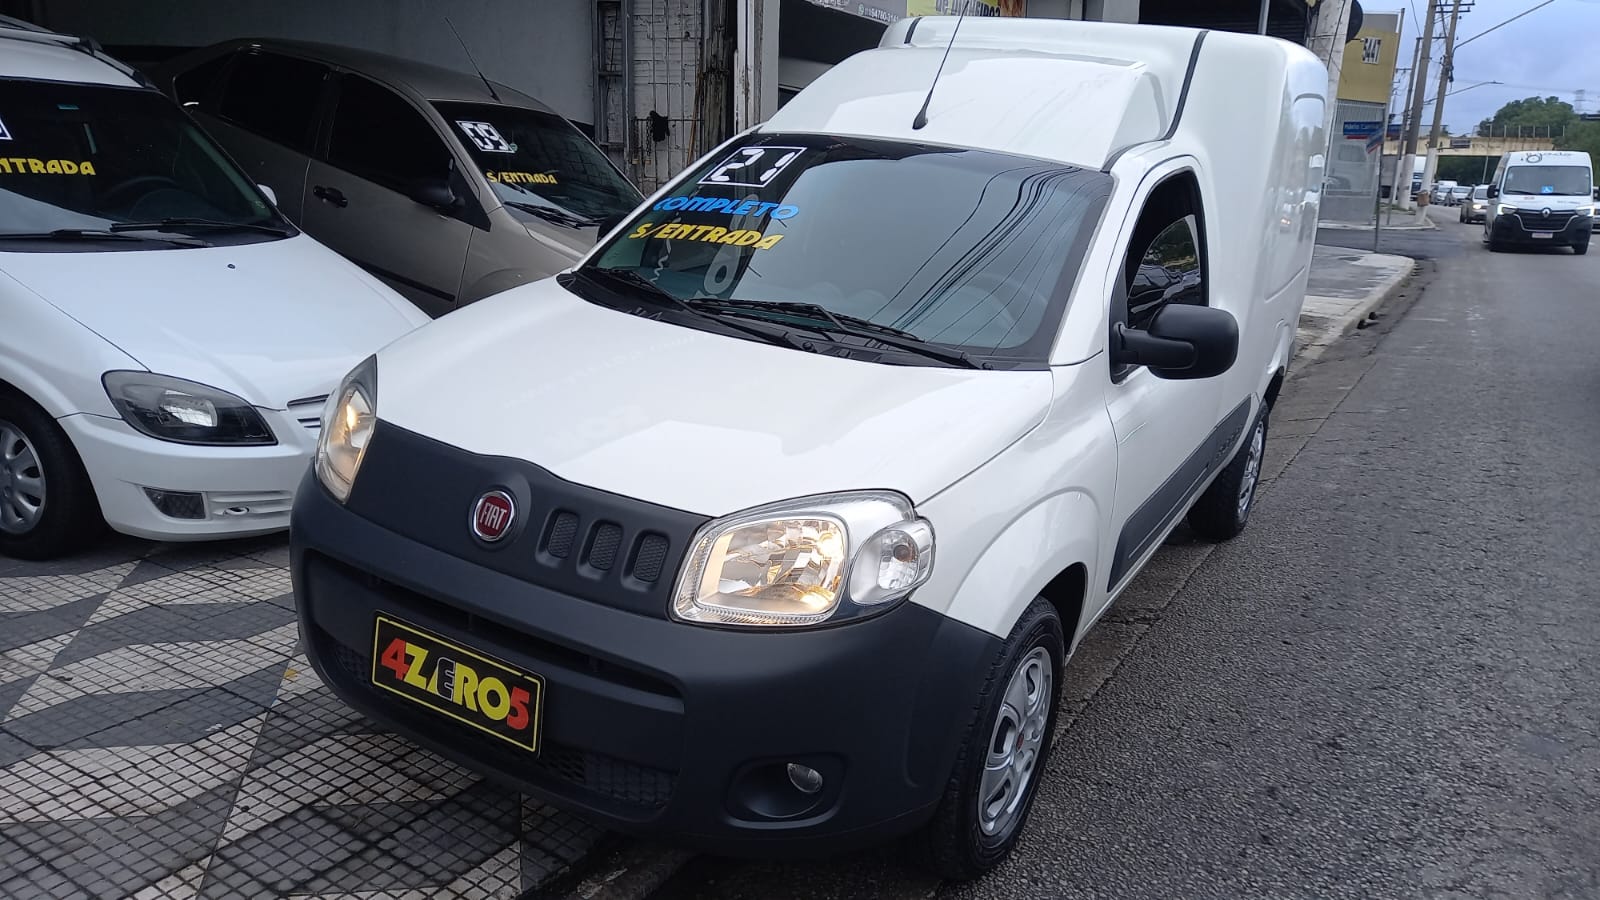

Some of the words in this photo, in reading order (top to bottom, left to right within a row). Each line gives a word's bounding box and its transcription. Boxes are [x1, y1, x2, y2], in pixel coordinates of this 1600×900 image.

[486, 171, 558, 184] S/ENTRADA
[710, 149, 795, 181] 21
[653, 197, 799, 219] COMPLETO
[629, 223, 784, 250] S/ENTRADA
[480, 502, 507, 530] FIAT
[381, 638, 530, 730] 4ZERO5
